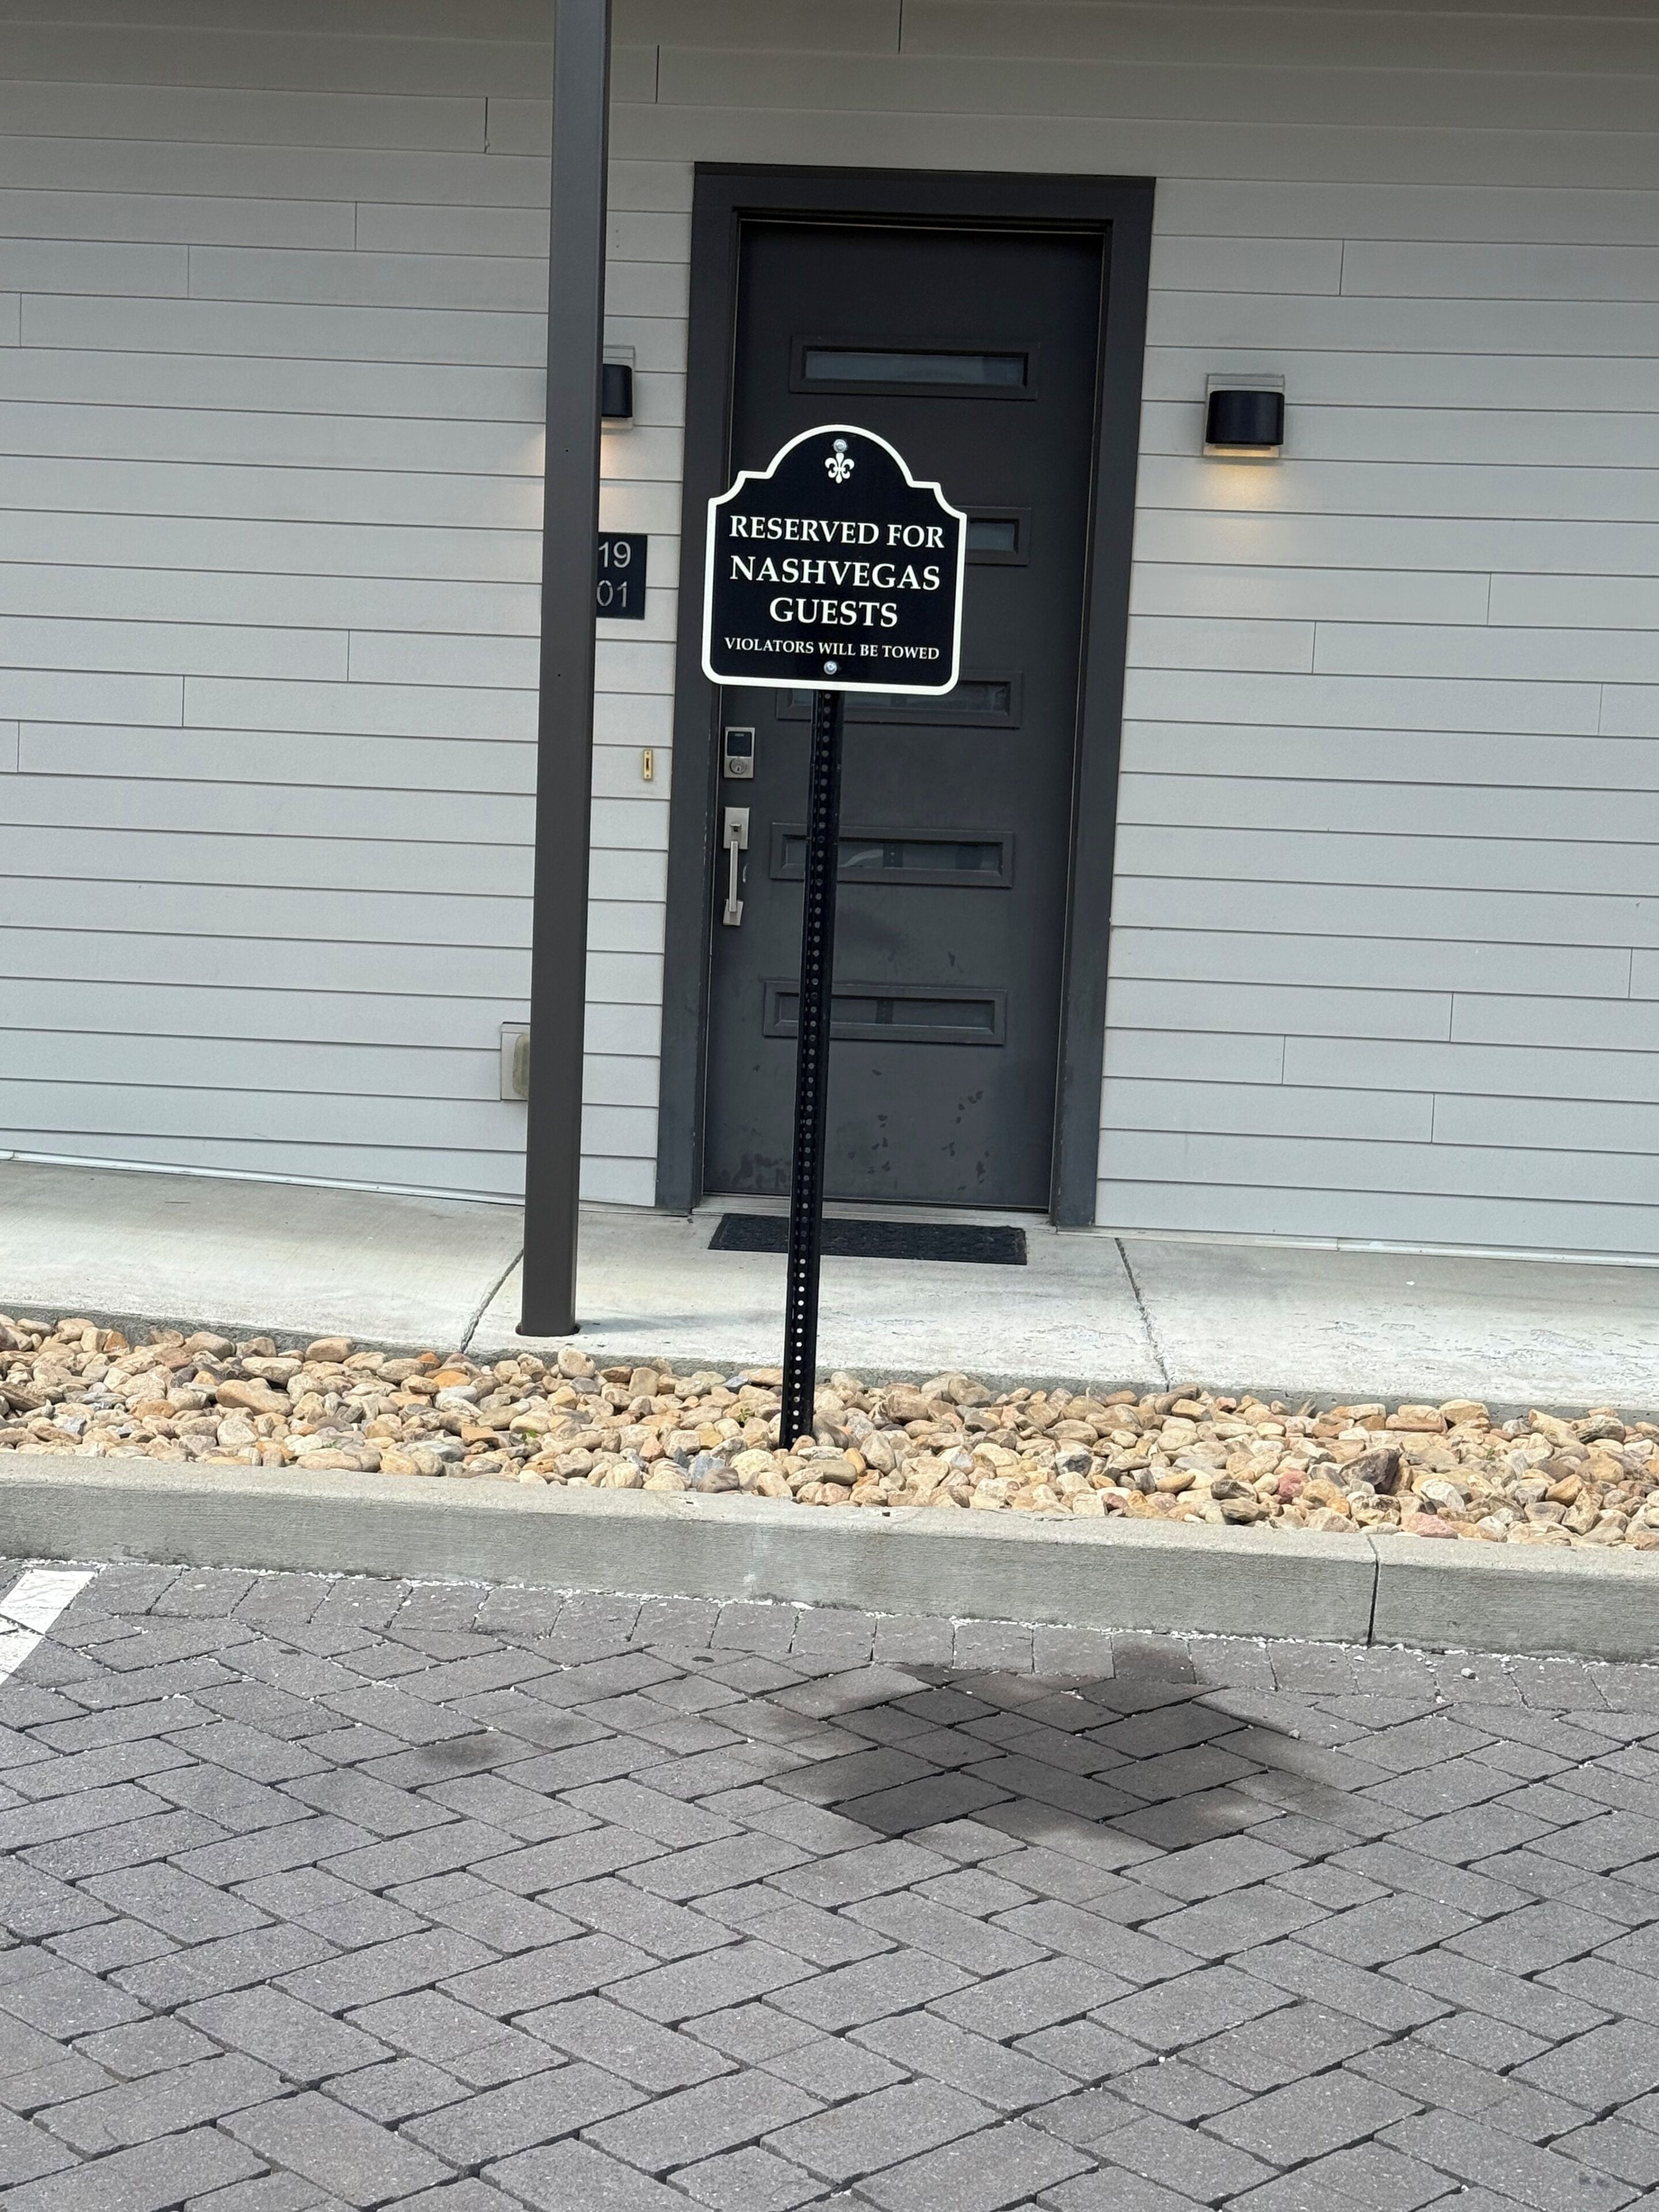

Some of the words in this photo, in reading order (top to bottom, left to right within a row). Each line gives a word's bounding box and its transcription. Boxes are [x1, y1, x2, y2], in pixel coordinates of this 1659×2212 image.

[729, 515, 879, 544] RESERVED
[886, 524, 945, 548] FOR
[598, 541, 631, 569] 19
[730, 555, 940, 590] NASHVEGAS
[596, 579, 628, 608] 01
[770, 597, 897, 627] GUESTS
[724, 637, 814, 654] VIOLATORS
[818, 642, 856, 656] WILL
[860, 644, 878, 657] BE
[881, 645, 940, 660] TOWED
